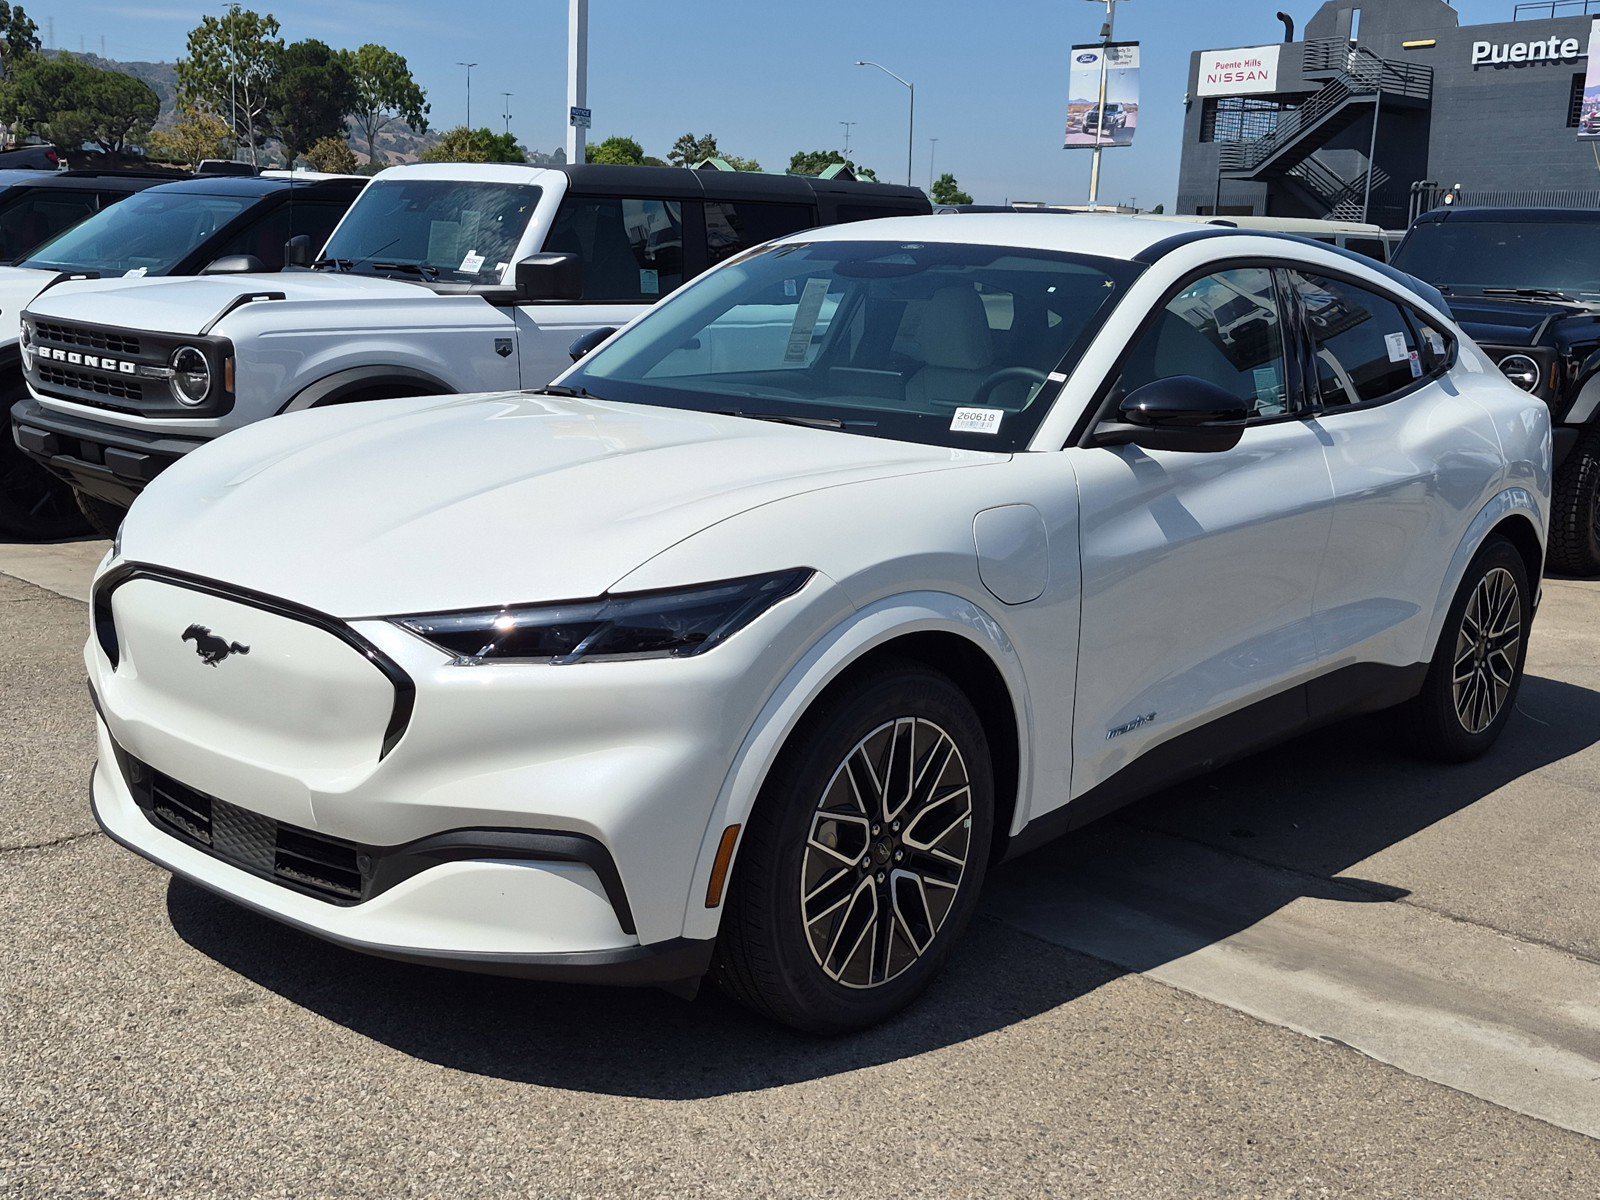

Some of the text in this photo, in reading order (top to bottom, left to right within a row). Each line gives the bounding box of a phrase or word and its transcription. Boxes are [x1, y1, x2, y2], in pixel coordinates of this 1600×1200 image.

[1471, 35, 1579, 64] Puente
[1215, 59, 1262, 70] Puente Hills
[1207, 70, 1268, 84] NISSAN
[38, 346, 136, 374] BRONCO
[957, 411, 995, 422] 260618
